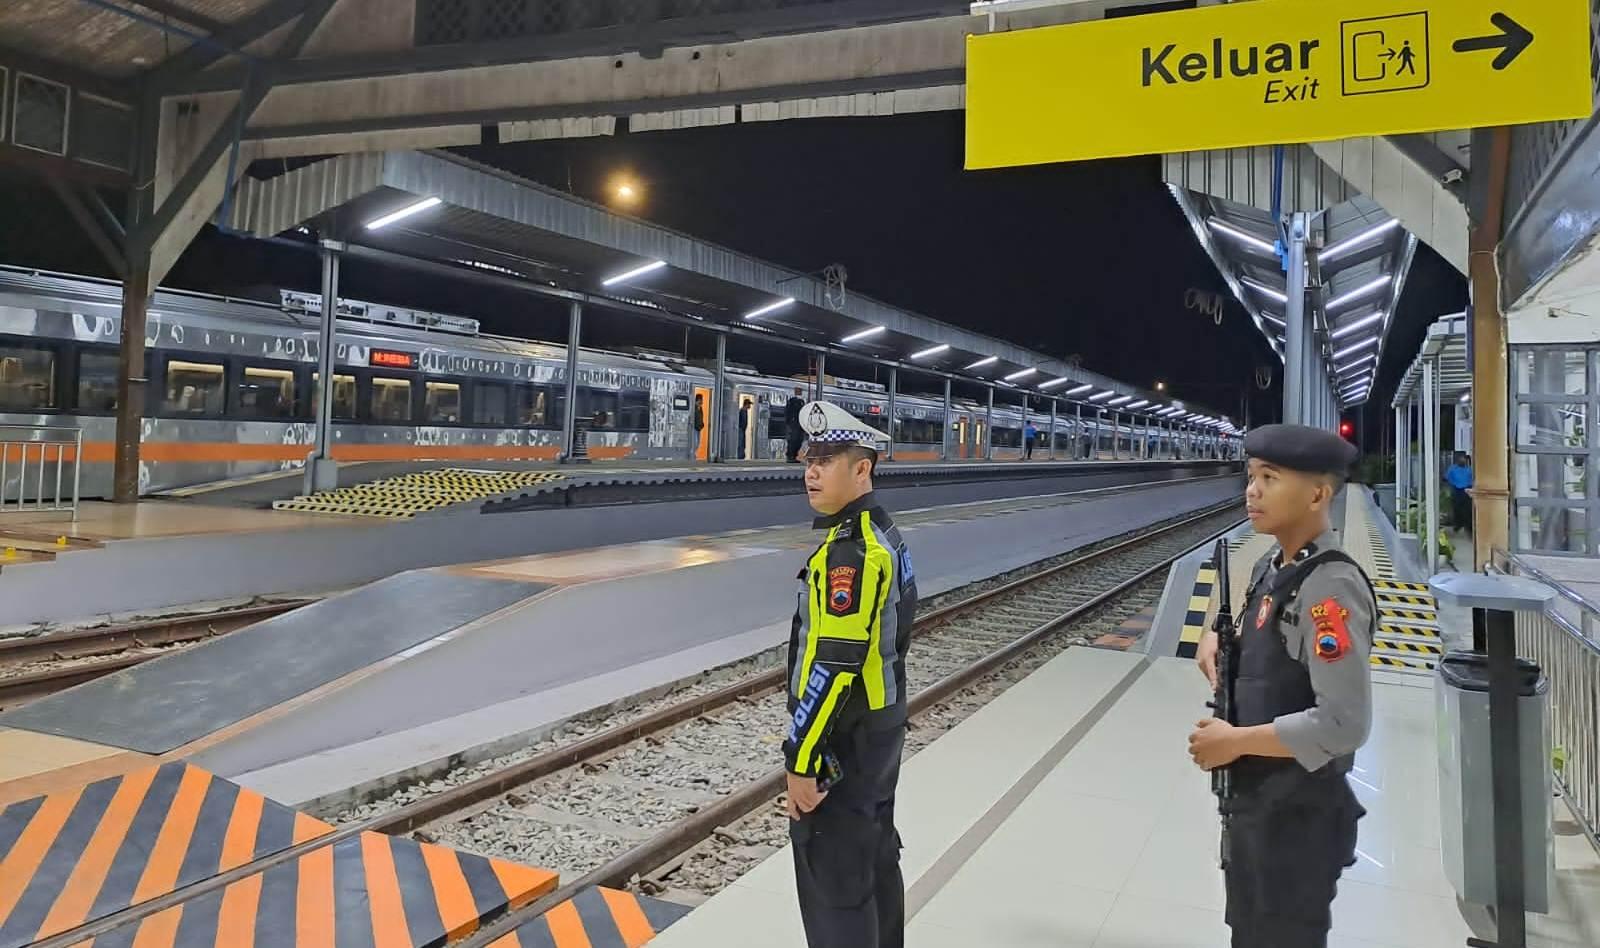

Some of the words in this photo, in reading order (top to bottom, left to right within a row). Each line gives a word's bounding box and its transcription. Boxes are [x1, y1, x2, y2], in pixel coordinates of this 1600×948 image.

[1142, 38, 1320, 87] Keluar
[1264, 76, 1320, 104] Exit
[788, 663, 831, 744] POLISI
